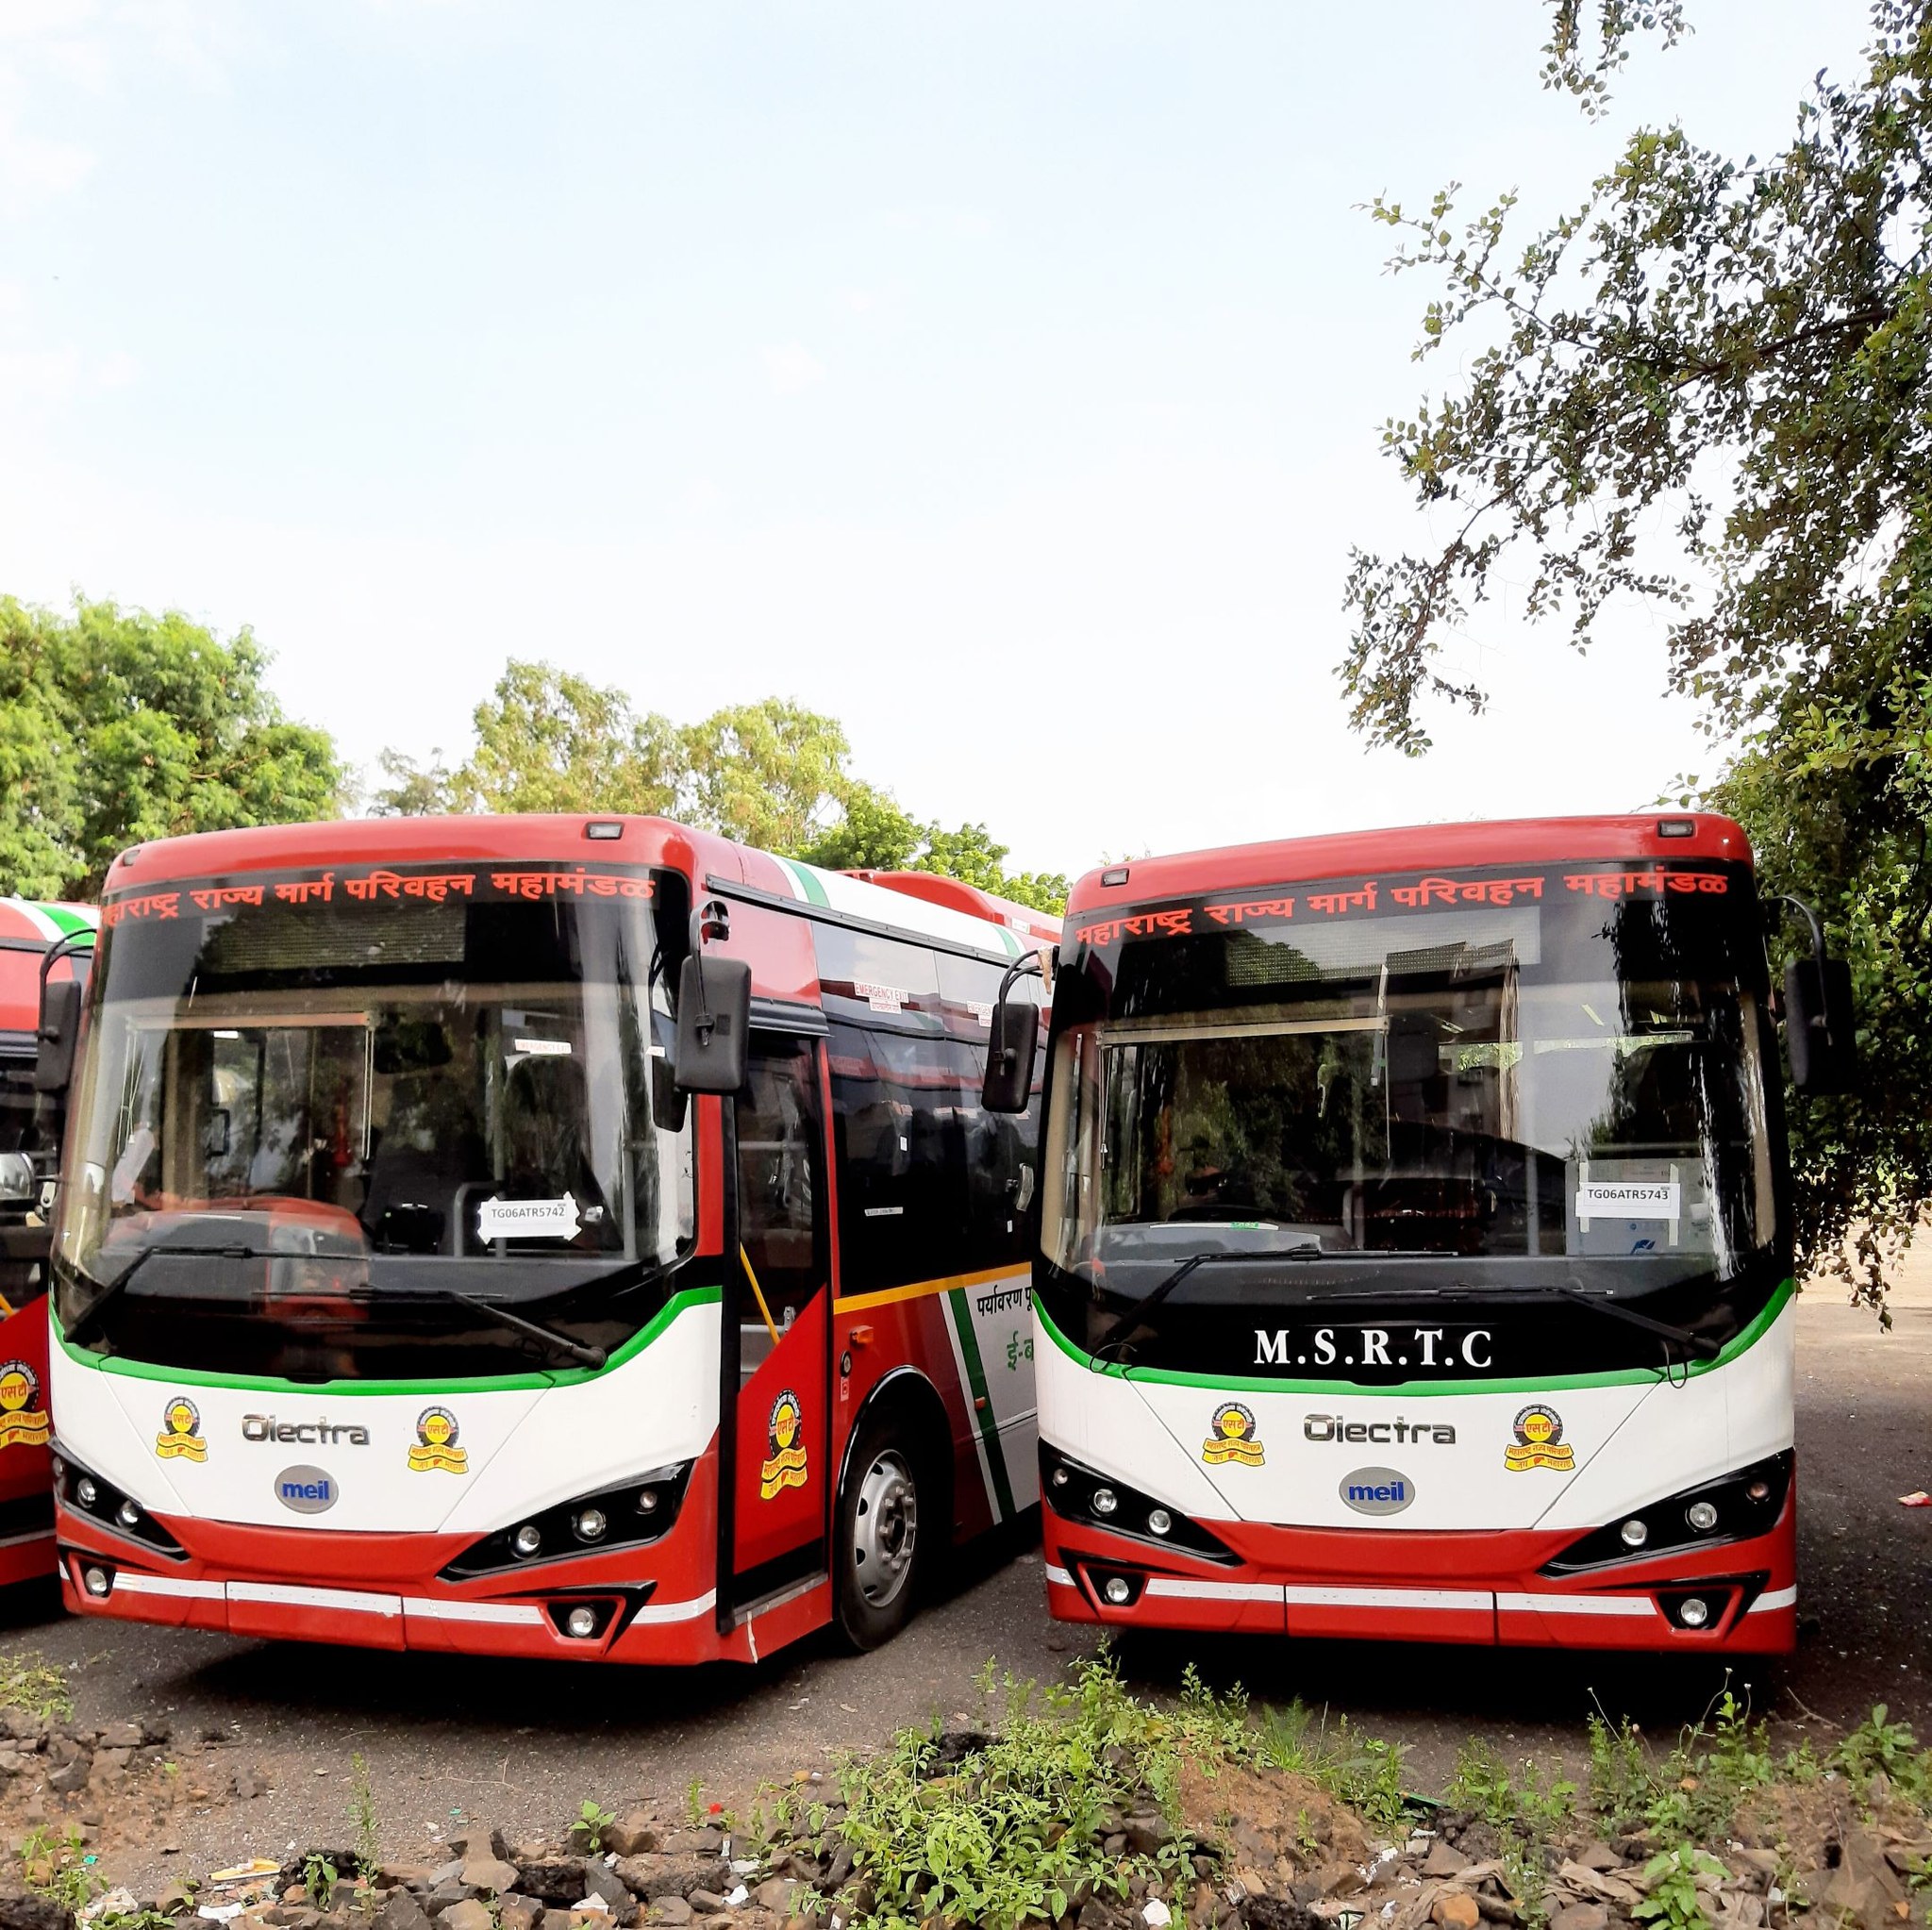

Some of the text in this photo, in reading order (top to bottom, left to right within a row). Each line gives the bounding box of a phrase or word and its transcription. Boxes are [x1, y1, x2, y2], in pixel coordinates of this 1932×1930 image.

[190, 885, 265, 909] राज्य
[275, 873, 335, 904] मार्ग
[344, 870, 476, 902] परिवहन
[491, 867, 656, 900] महामंडळ
[1074, 865, 1729, 945] महाराष्ट्र राज्य मार्ग परिवहन महामंडळ
[855, 982, 908, 1002] EMERGENCY EXIT
[968, 1002, 992, 1015] EMERGEN
[1587, 1189, 1669, 1200] TG06ATR5743
[491, 1206, 565, 1218] TG06ATR5742
[976, 1285, 1024, 1317] पर्यावरण
[1007, 1331, 1034, 1372] ई-ब
[1253, 1328, 1491, 1368] M.S.R.T.C
[1303, 1414, 1457, 1444] Olectra
[282, 1480, 330, 1500] meil
[1348, 1481, 1405, 1502] meil
